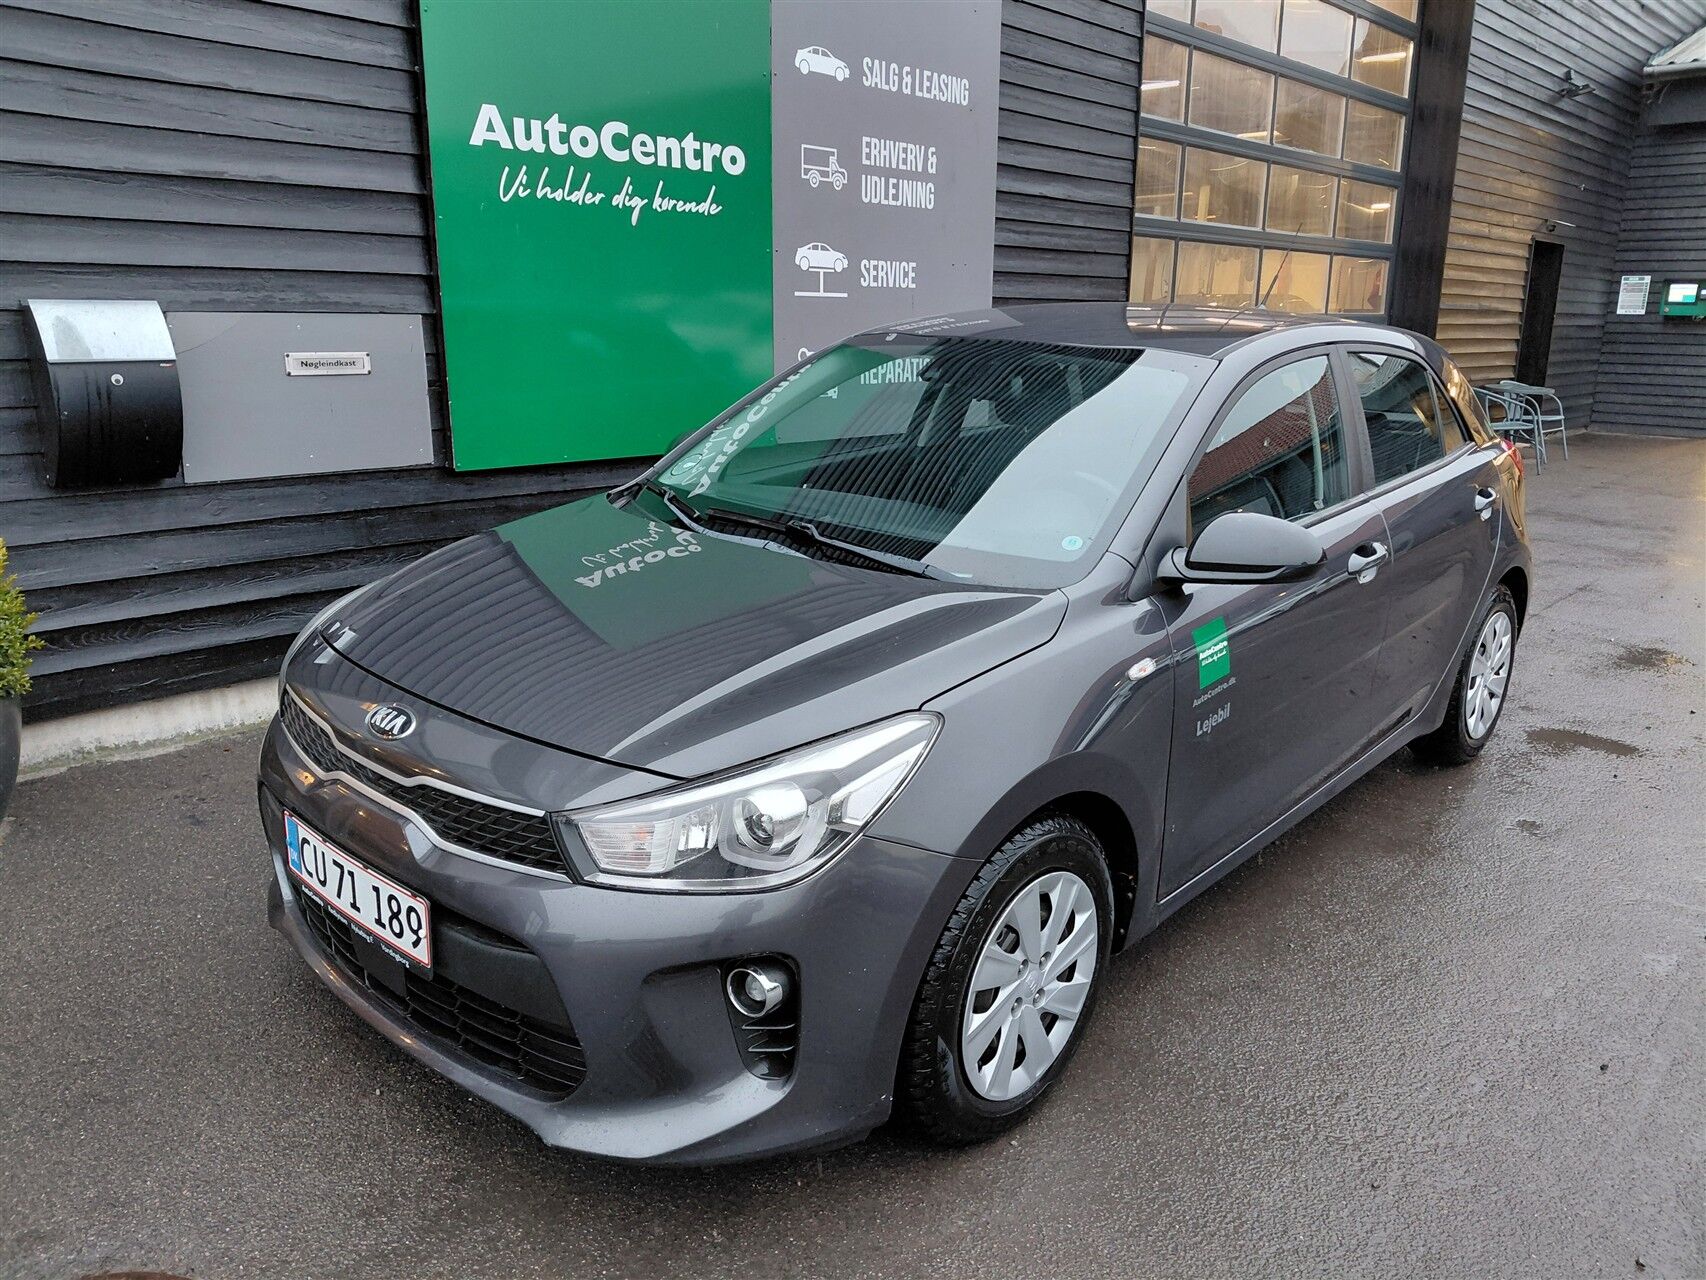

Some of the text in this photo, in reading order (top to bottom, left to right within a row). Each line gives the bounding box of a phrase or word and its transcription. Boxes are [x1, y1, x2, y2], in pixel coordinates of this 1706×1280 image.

[862, 56, 969, 106] SALG & LEASING
[469, 103, 746, 176] AutoCentro
[862, 136, 937, 174] ERHVERV &
[499, 165, 531, 202] Vi
[536, 165, 606, 205] holder
[612, 176, 648, 226] dig
[861, 174, 935, 210] UDLEJNING
[860, 259, 917, 289] SERVICE
[300, 360, 356, 369] Nøgleindkast
[860, 358, 931, 385] EPARATI
[370, 707, 407, 735] KIA
[1196, 702, 1231, 736] Lejebil
[300, 837, 328, 887] CU
[332, 858, 361, 914] 71
[371, 884, 424, 949] 189
